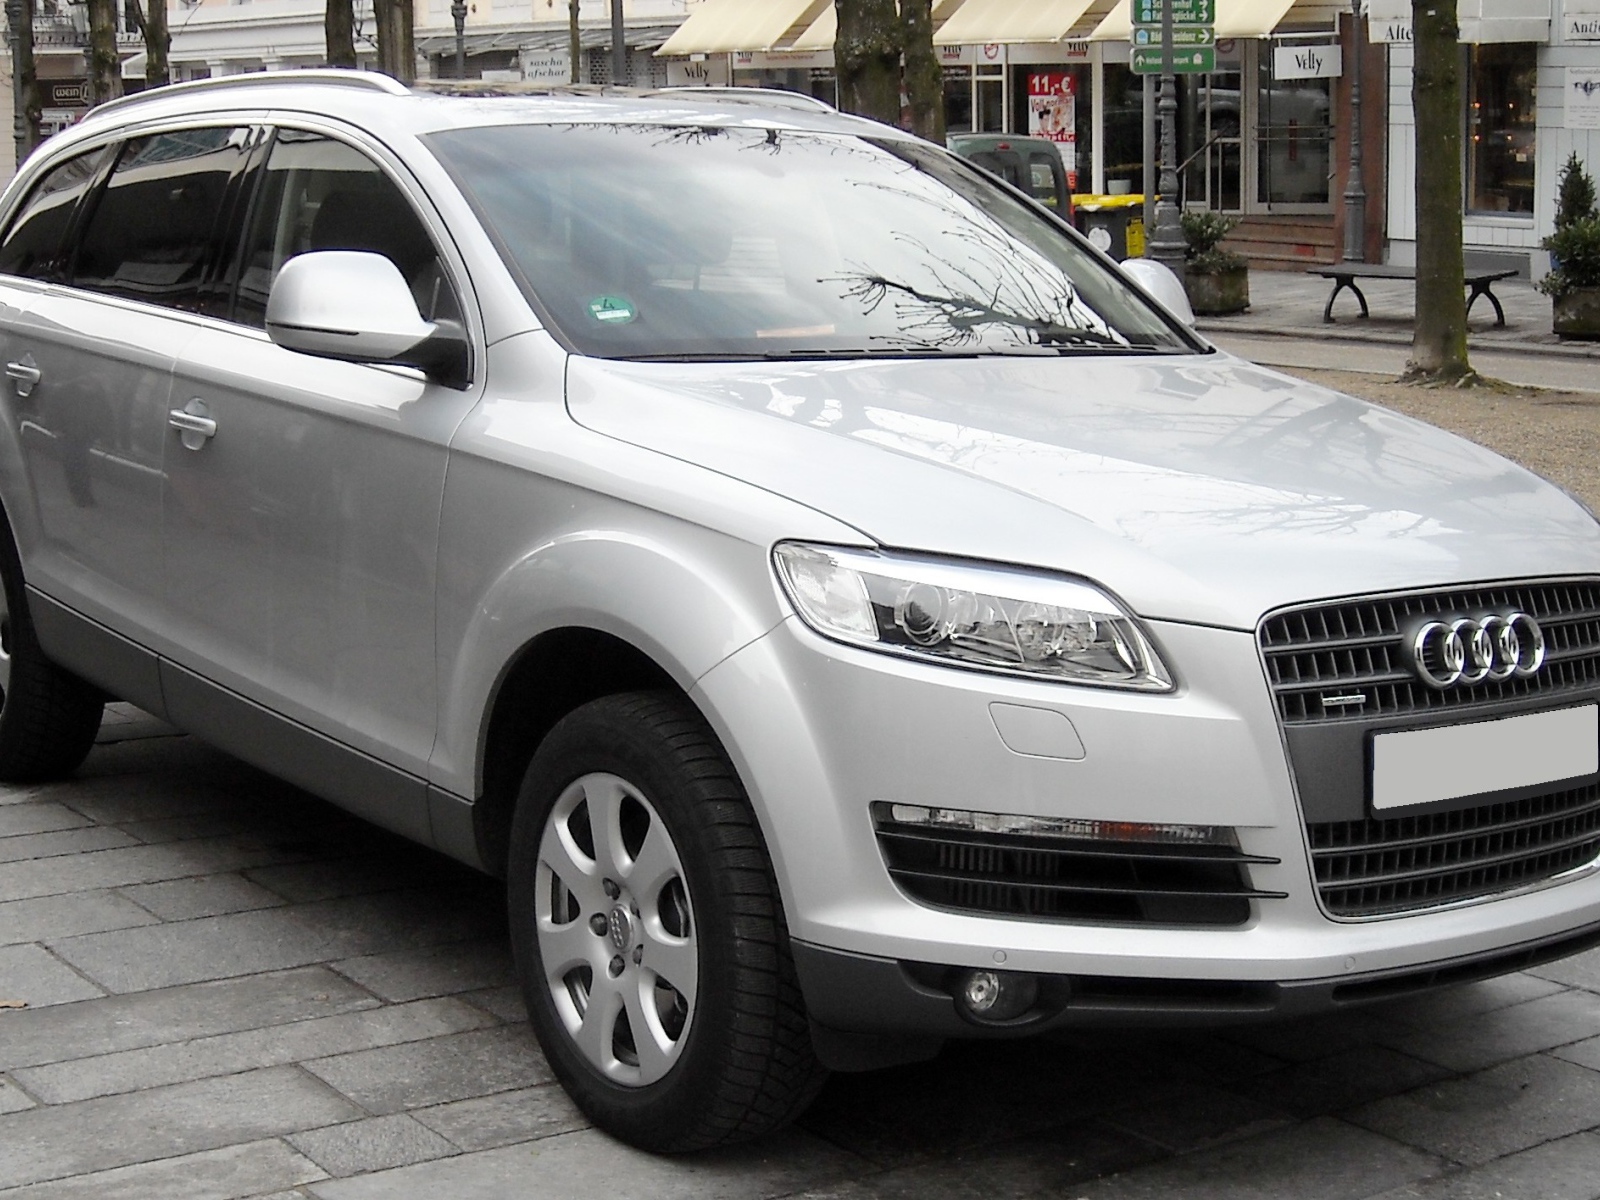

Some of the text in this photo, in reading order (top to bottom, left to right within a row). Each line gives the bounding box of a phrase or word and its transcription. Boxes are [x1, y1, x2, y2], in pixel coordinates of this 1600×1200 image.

[530, 57, 563, 66] sascha
[1295, 49, 1323, 76] Velly
[684, 62, 709, 81] Velly
